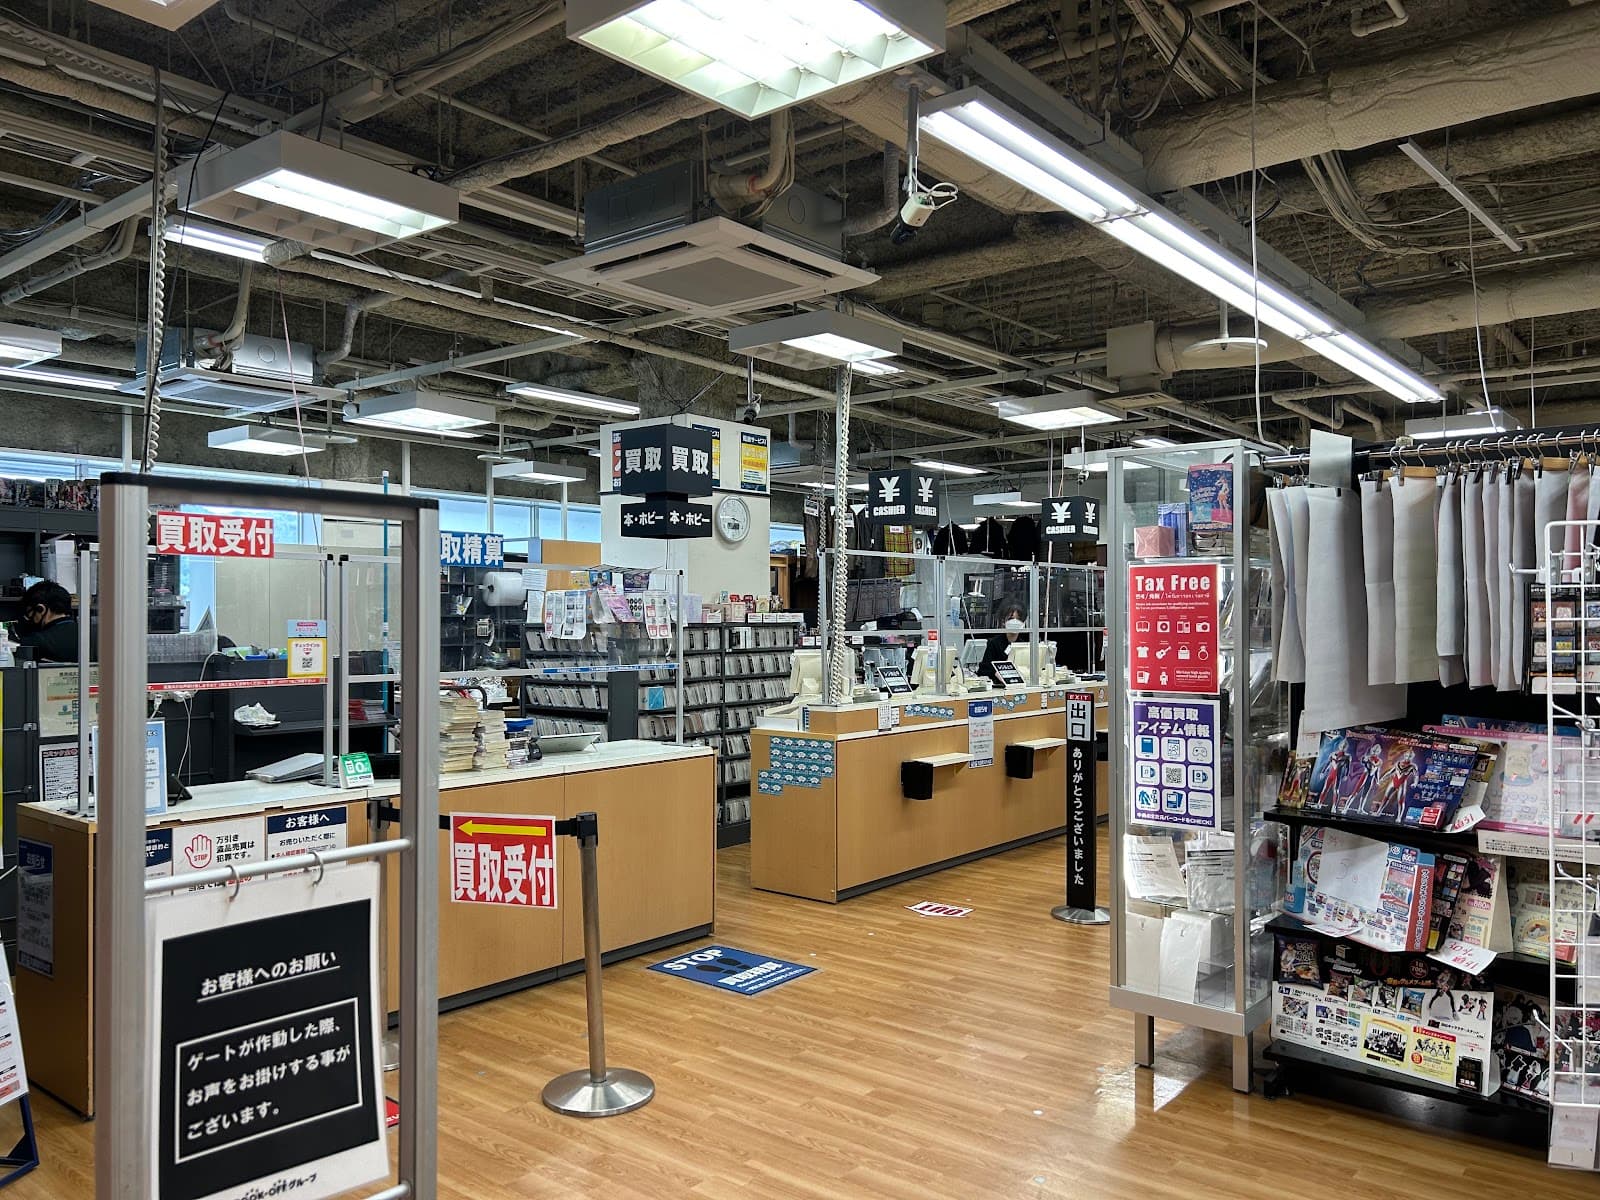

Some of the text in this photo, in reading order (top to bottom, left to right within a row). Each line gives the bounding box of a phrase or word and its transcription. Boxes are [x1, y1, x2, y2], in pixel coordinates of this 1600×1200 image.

[625, 446, 662, 475] 買取
[671, 445, 710, 476] 買取
[878, 476, 900, 502] ¥
[623, 510, 664, 527] 本・ホビー
[669, 509, 711, 526] 本・ホビー
[873, 504, 906, 517] CASHIER
[914, 504, 937, 517] CASHIER
[157, 514, 274, 556] 買取受付
[1046, 524, 1076, 535] CASHIER
[440, 532, 504, 566] 取精算
[1135, 574, 1211, 592] Tax Free
[1070, 702, 1086, 738] 出口
[1147, 705, 1199, 721] 高価買取
[1136, 721, 1210, 737] アイテム情報
[285, 812, 331, 829] お客様へ
[1072, 747, 1084, 885] ありがとうございました
[215, 834, 239, 846] 万引き
[193, 853, 208, 862] STOP
[454, 843, 555, 905] 買取受付
[201, 950, 338, 996] お客様へのお願い
[663, 949, 723, 971] STOP
[187, 1016, 342, 1071] ゲートが作動した際、
[186, 1045, 351, 1106] お声をお掛けする事が
[187, 1101, 280, 1140] ございます。
[234, 1172, 318, 1200] OOK-OFFグループ
